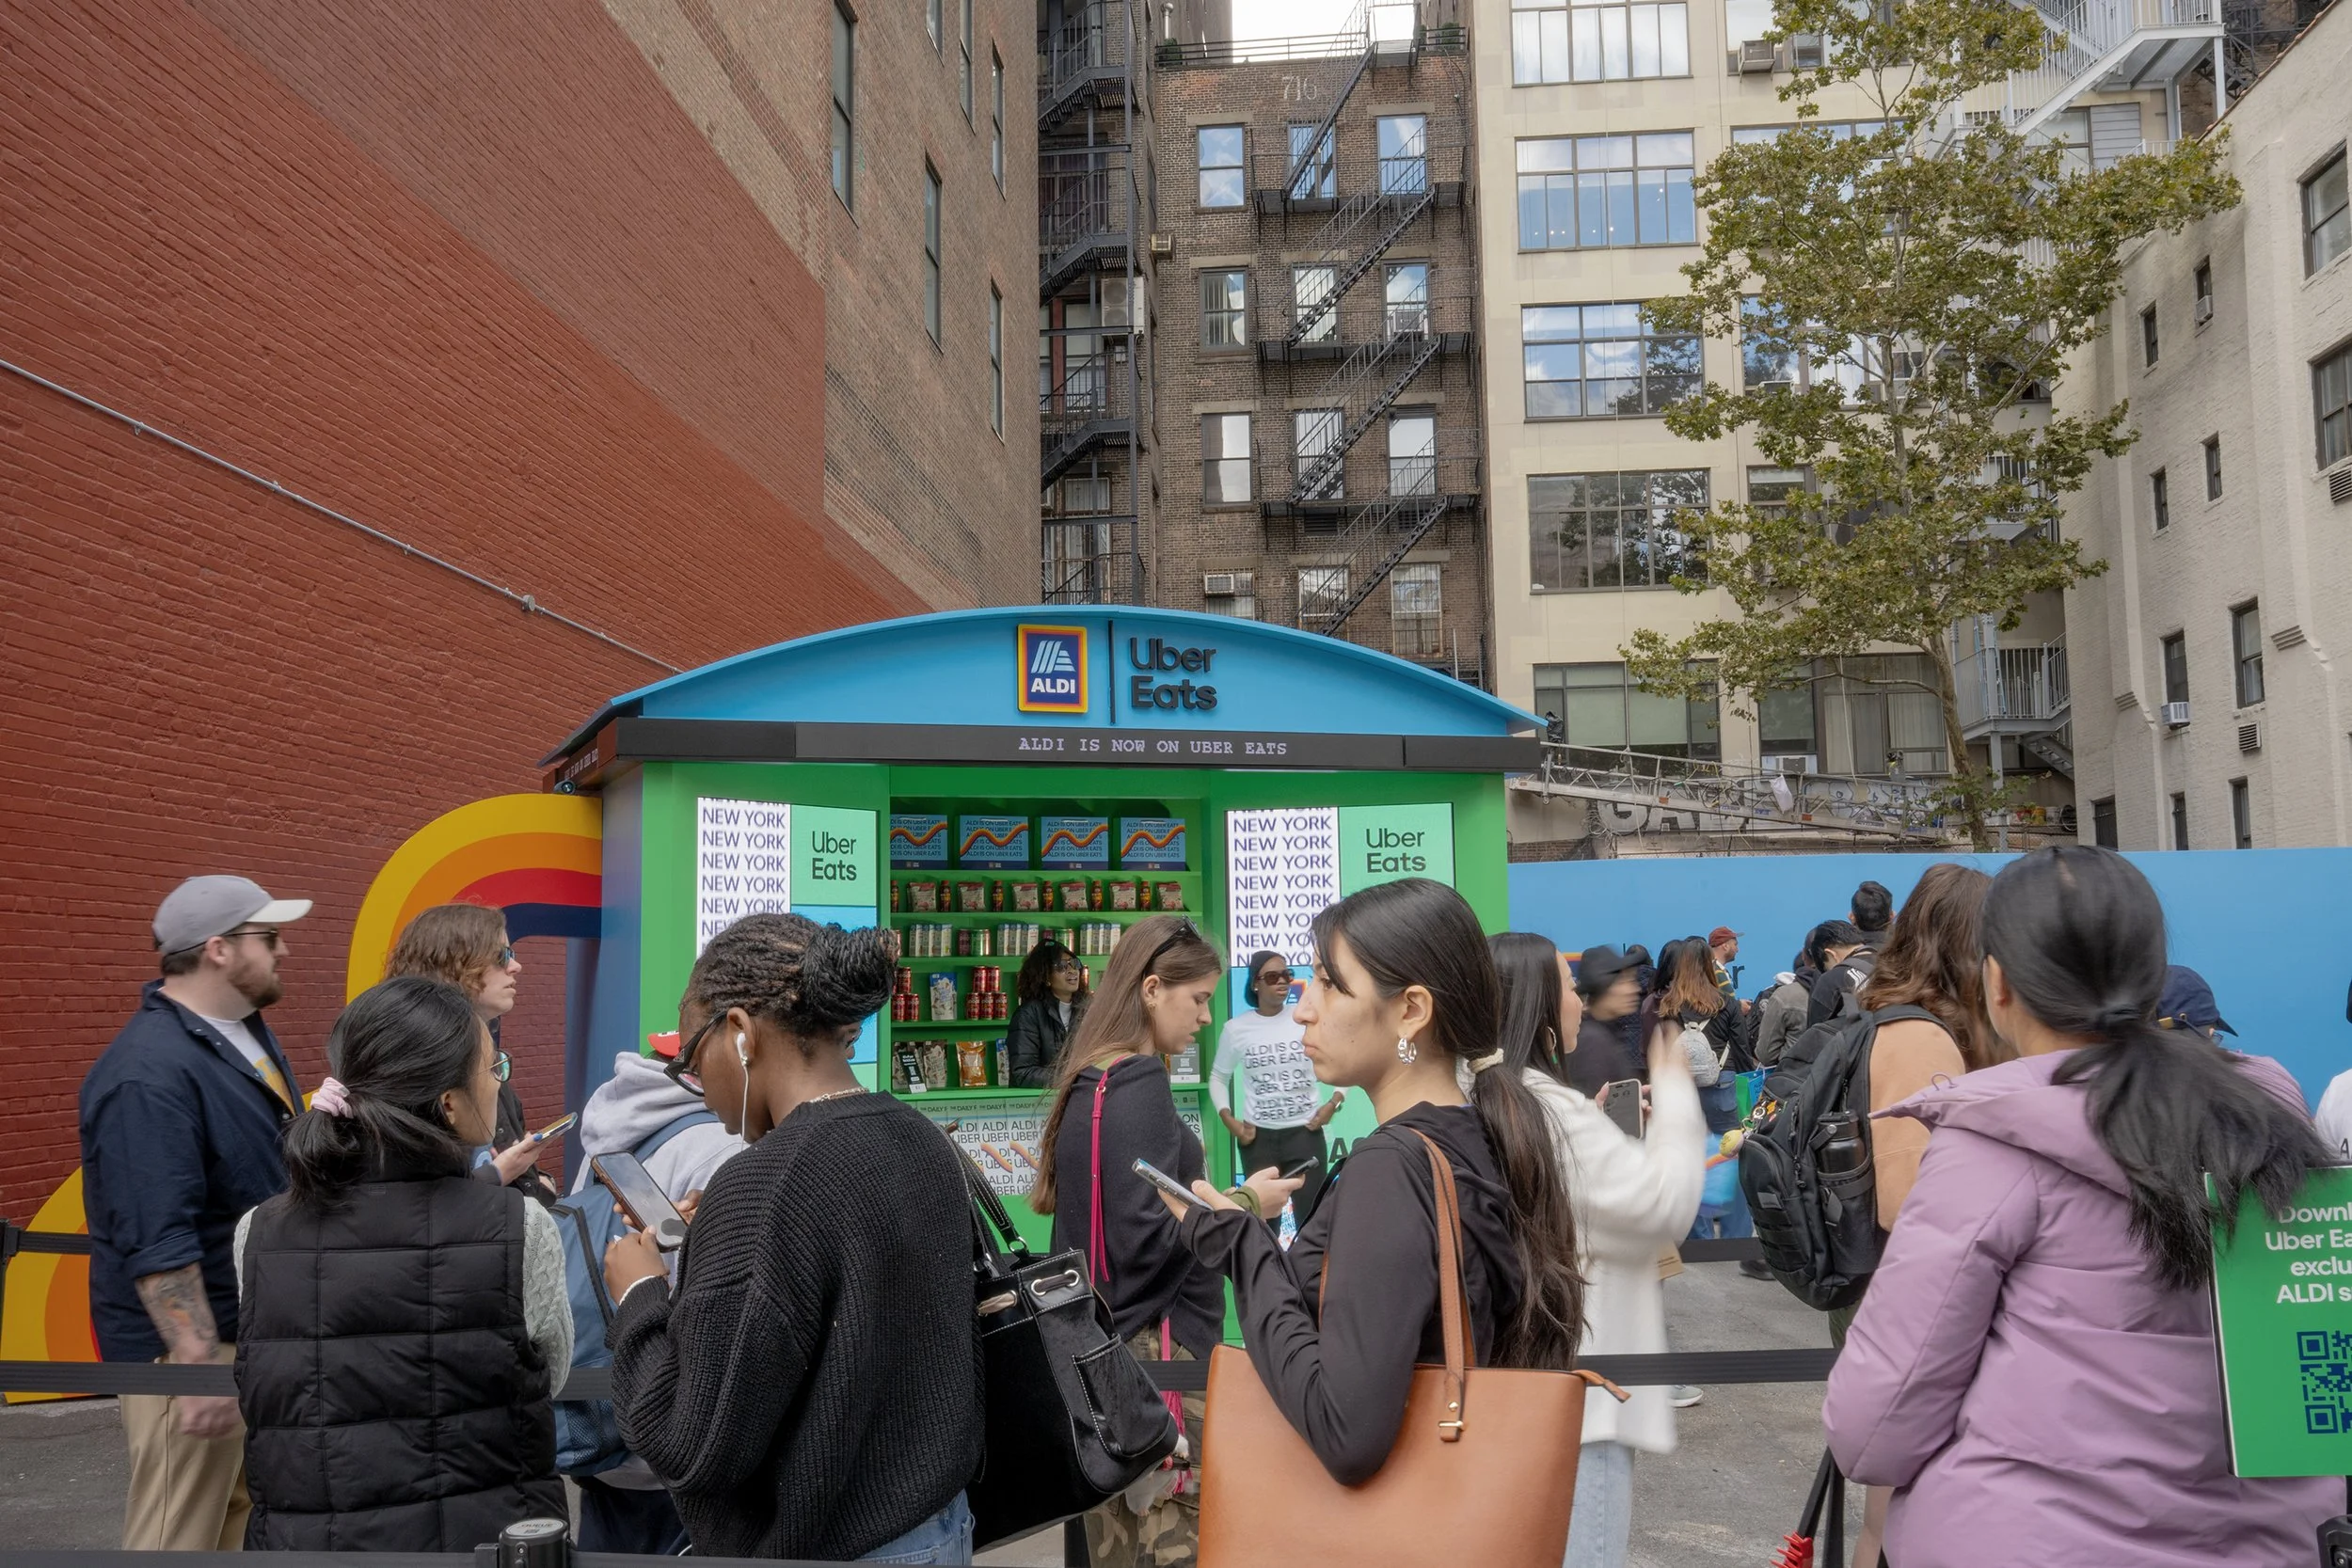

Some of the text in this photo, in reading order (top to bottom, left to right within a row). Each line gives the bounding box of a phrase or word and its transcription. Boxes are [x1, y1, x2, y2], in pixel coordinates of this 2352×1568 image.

[1282, 76, 1317, 100] 716
[1130, 637, 1216, 672] Uber
[1031, 678, 1076, 694] ALDI
[1131, 675, 1217, 710] Eats
[1019, 737, 1287, 754] ALDI IS NOW ON UBER EATS
[702, 808, 786, 829] NEW YORK
[1234, 816, 1332, 832] NEW YORK
[702, 831, 786, 851] NEW YORK
[812, 831, 857, 855] Uber
[1234, 835, 1333, 852] NEW YORK
[1366, 828, 1425, 848] Uber
[702, 853, 786, 872] NEW YORK
[812, 857, 858, 881] Eats
[1234, 854, 1333, 871] NEW YORK
[1367, 853, 1426, 873] Eats
[702, 875, 786, 894] NEW YORK
[1235, 873, 1334, 890] NEW YORK
[702, 898, 786, 914] NEW YORK
[1235, 893, 1334, 910] NEW YORK
[1236, 913, 1317, 929] NEW YO
[1237, 933, 1312, 948] NEW YO
[1286, 952, 1312, 966] YO
[1245, 1040, 1304, 1056] ALDI IS O
[1245, 1055, 1276, 1069] UBER
[982, 1121, 1007, 1131] ALDI
[1011, 1120, 1036, 1130] ALDI
[1182, 1113, 1199, 1123] ON
[983, 1132, 1009, 1143] UBER
[1012, 1131, 1038, 1141] UBER
[989, 1175, 1013, 1184] ALDI
[1017, 1174, 1036, 1184] ALD
[2265, 1231, 2324, 1251] Uber
[2277, 1283, 2352, 1304] ALDI s
